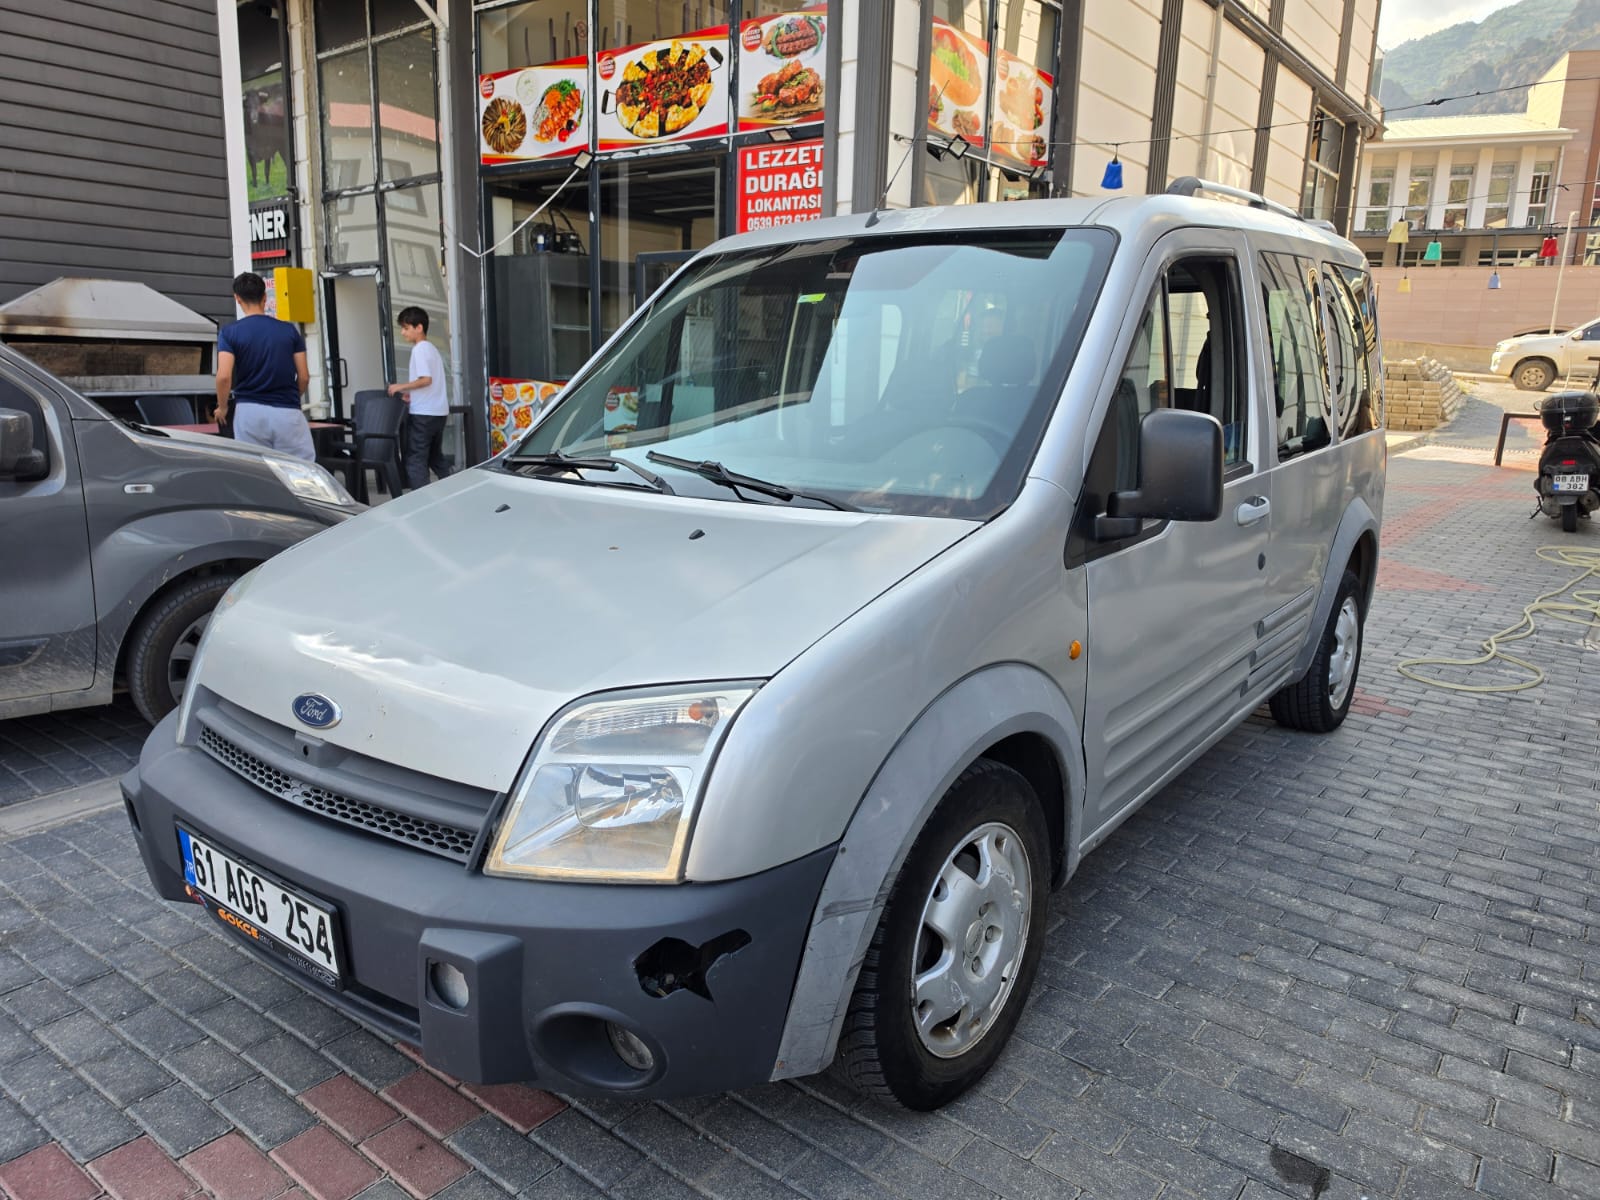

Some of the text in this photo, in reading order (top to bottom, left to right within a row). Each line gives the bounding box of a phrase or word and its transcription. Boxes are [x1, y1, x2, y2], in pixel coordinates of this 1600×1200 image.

[746, 145, 824, 170] LEZZET
[746, 167, 824, 194] DURAĞI
[747, 194, 822, 214] LOKANTASI
[250, 210, 286, 241] NER
[747, 216, 772, 231] 0539
[300, 697, 328, 721] Ford
[192, 841, 217, 895] 61
[225, 859, 269, 925] AGG
[281, 892, 333, 965] 254
